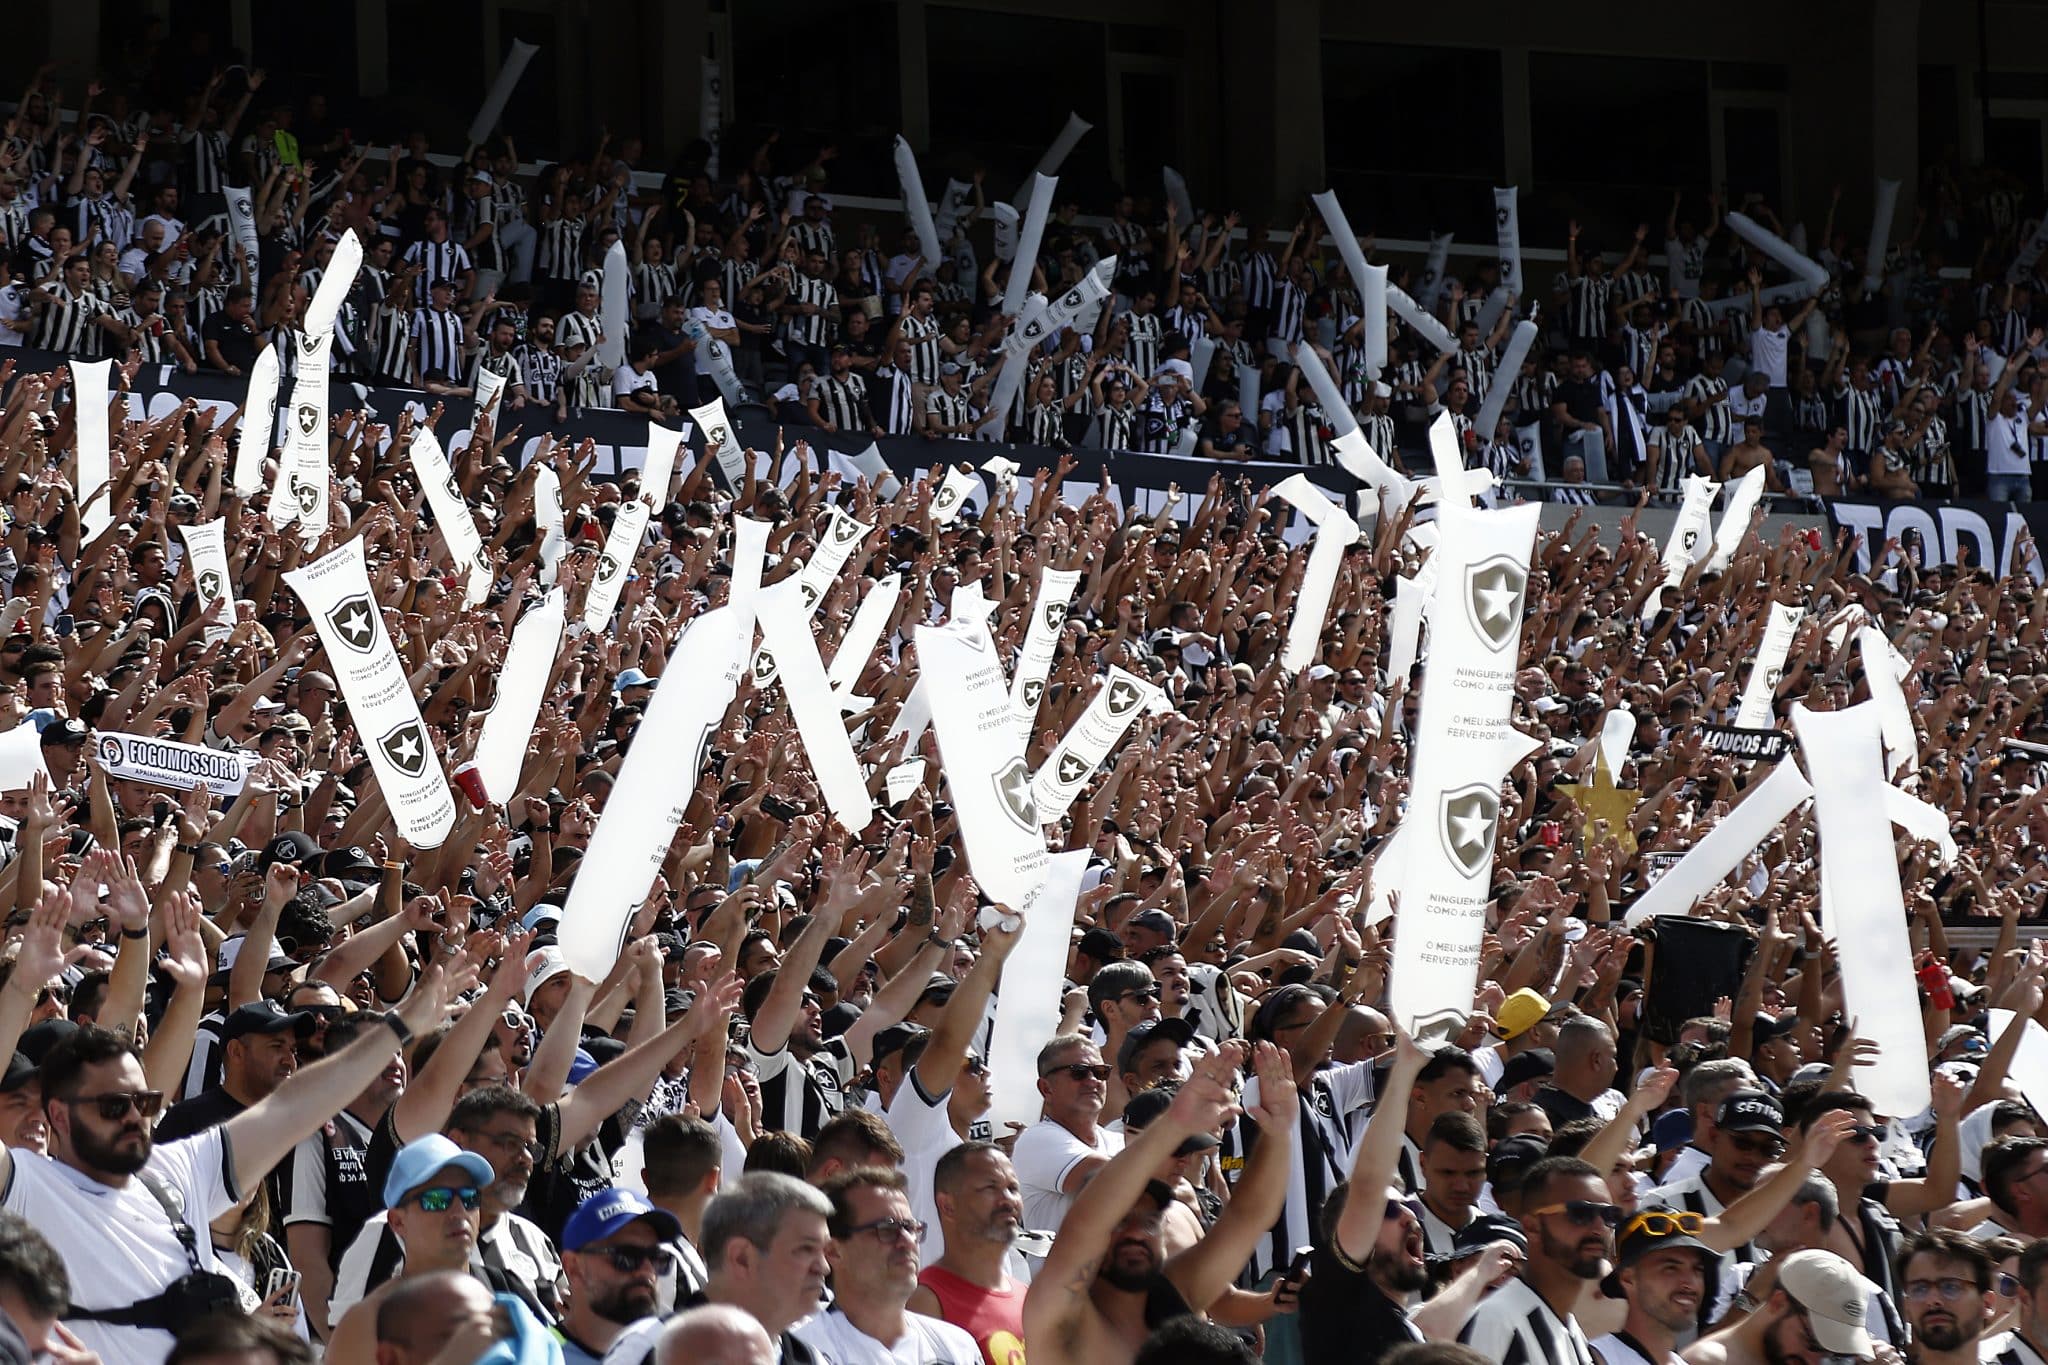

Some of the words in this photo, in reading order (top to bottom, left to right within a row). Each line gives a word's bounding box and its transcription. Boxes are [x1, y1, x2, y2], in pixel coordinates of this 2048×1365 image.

[1831, 502, 2046, 588] TODA
[1453, 679, 1485, 690] COMO
[1454, 714, 1460, 724] O
[1462, 716, 1483, 726] MEU
[1447, 726, 1479, 740] FERVE
[1480, 731, 1497, 740] POR
[1701, 730, 1762, 755] LOUCOS
[1761, 736, 1782, 756] JF
[128, 740, 240, 781] FOGOMOSSORÓ
[1426, 904, 1458, 916] COMO
[1426, 940, 1434, 950] O
[1436, 942, 1456, 952] MEU
[1420, 952, 1450, 966] FERVE
